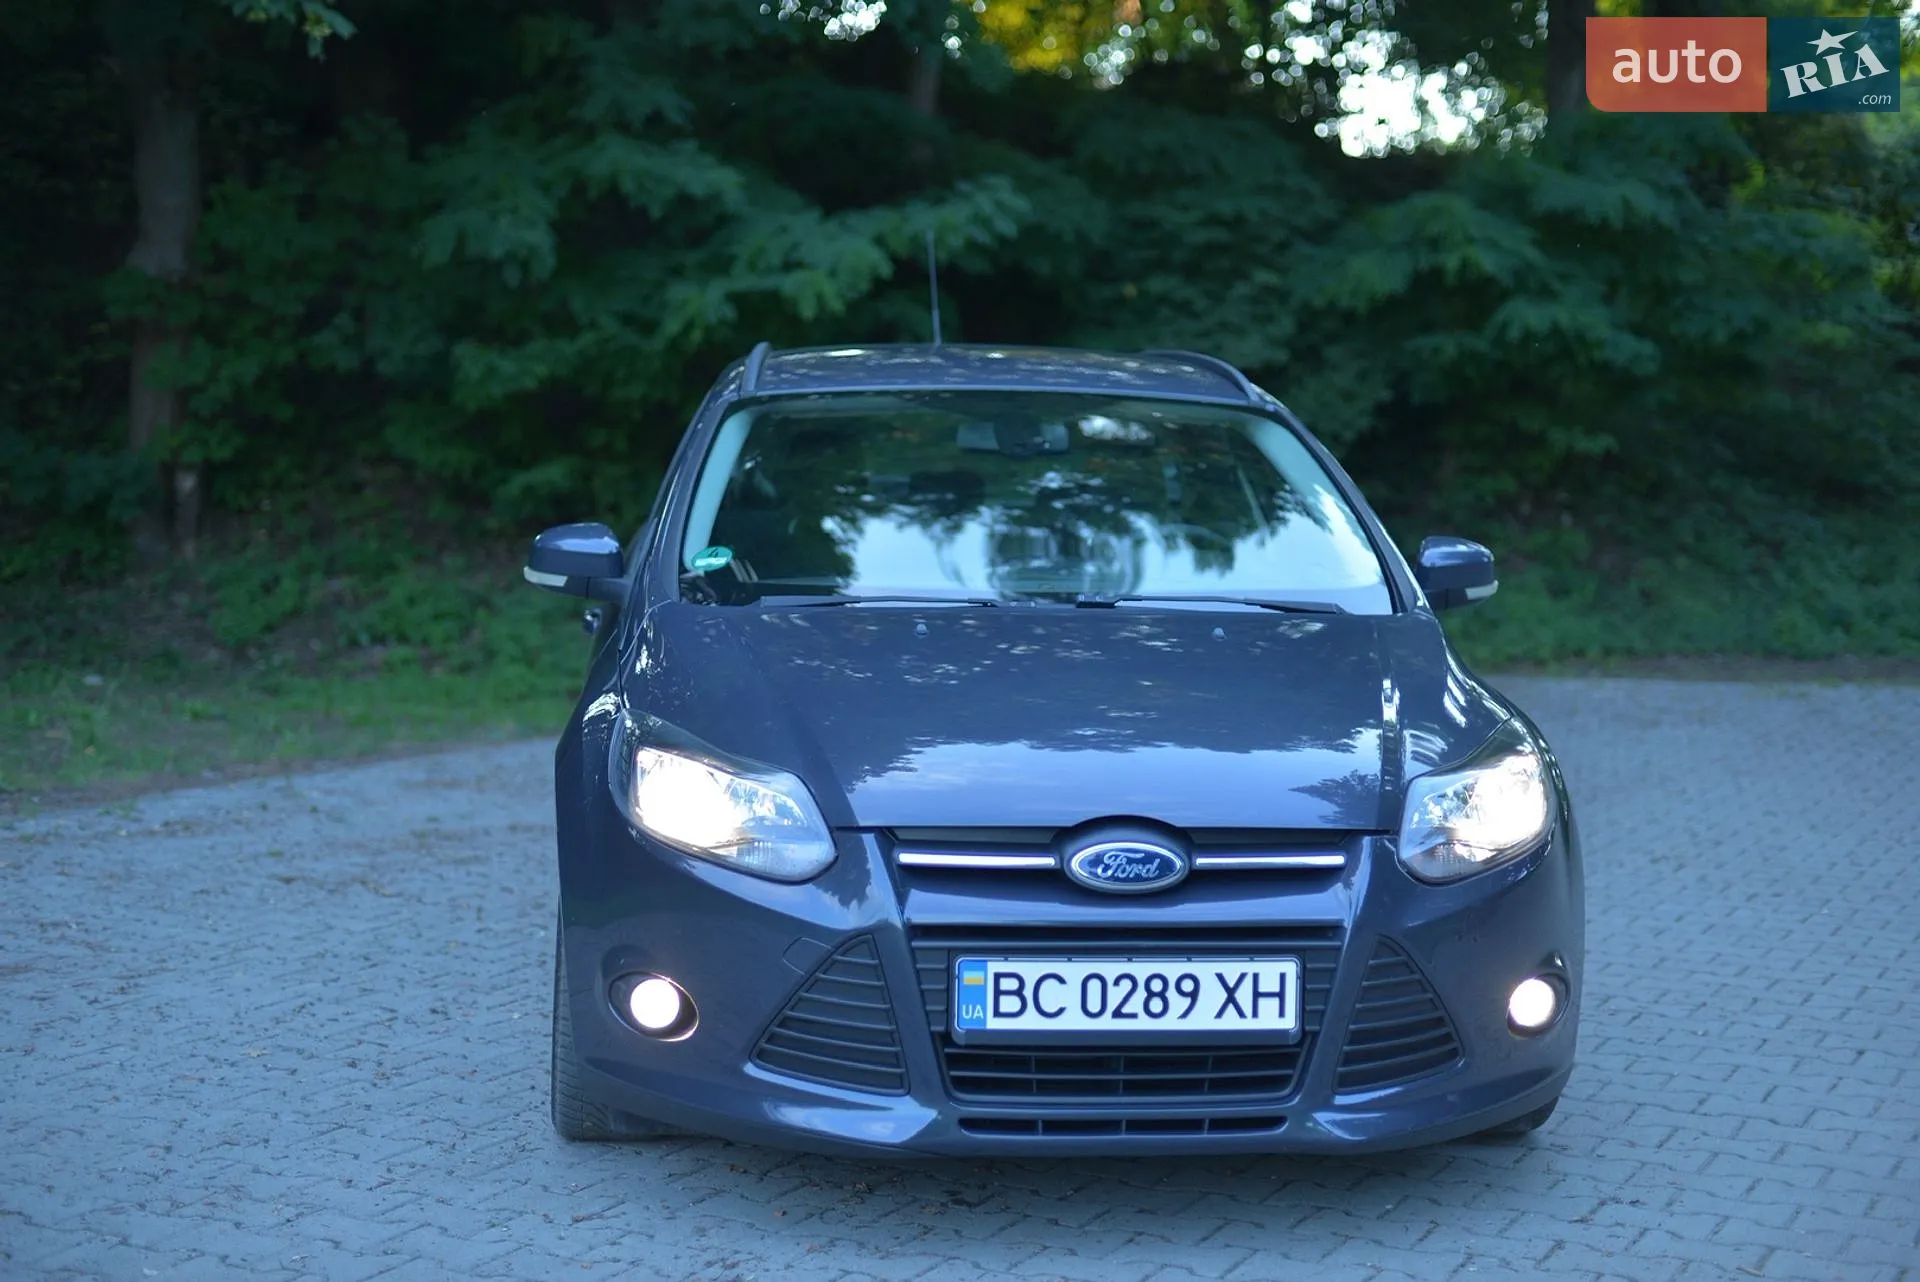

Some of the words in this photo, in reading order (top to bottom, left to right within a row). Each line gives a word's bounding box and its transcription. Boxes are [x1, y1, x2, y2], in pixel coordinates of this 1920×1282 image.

[1097, 851, 1160, 878] Ford
[992, 972, 1067, 1019] BC
[1080, 972, 1201, 1019] 0289
[1214, 972, 1287, 1019] XH
[962, 1005, 984, 1020] UA
